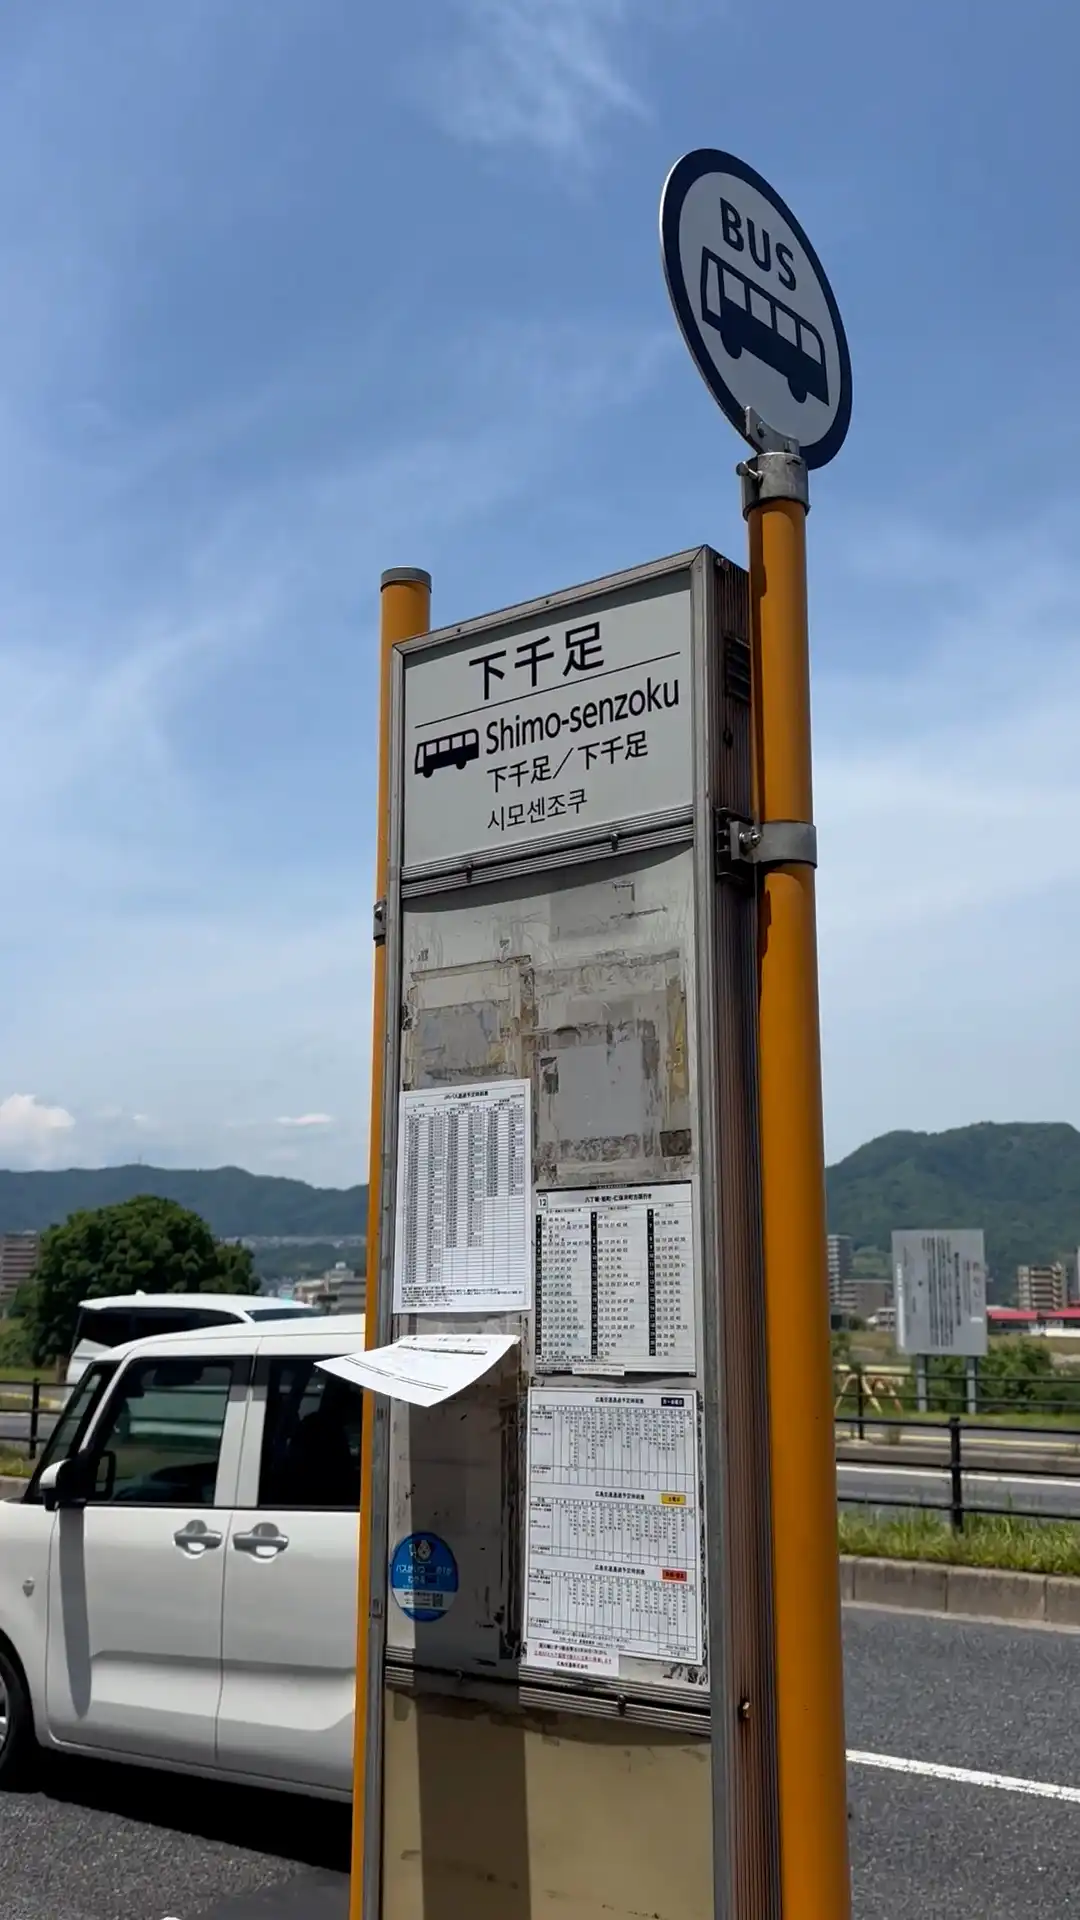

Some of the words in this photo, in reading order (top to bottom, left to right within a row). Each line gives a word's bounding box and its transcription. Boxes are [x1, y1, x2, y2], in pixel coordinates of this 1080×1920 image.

[720, 197, 797, 292] BUS
[469, 621, 604, 700] 下千足
[486, 677, 679, 755] Shimo-senzoku
[487, 789, 588, 831] 시모센조쿠
[538, 1198, 547, 1207] 12
